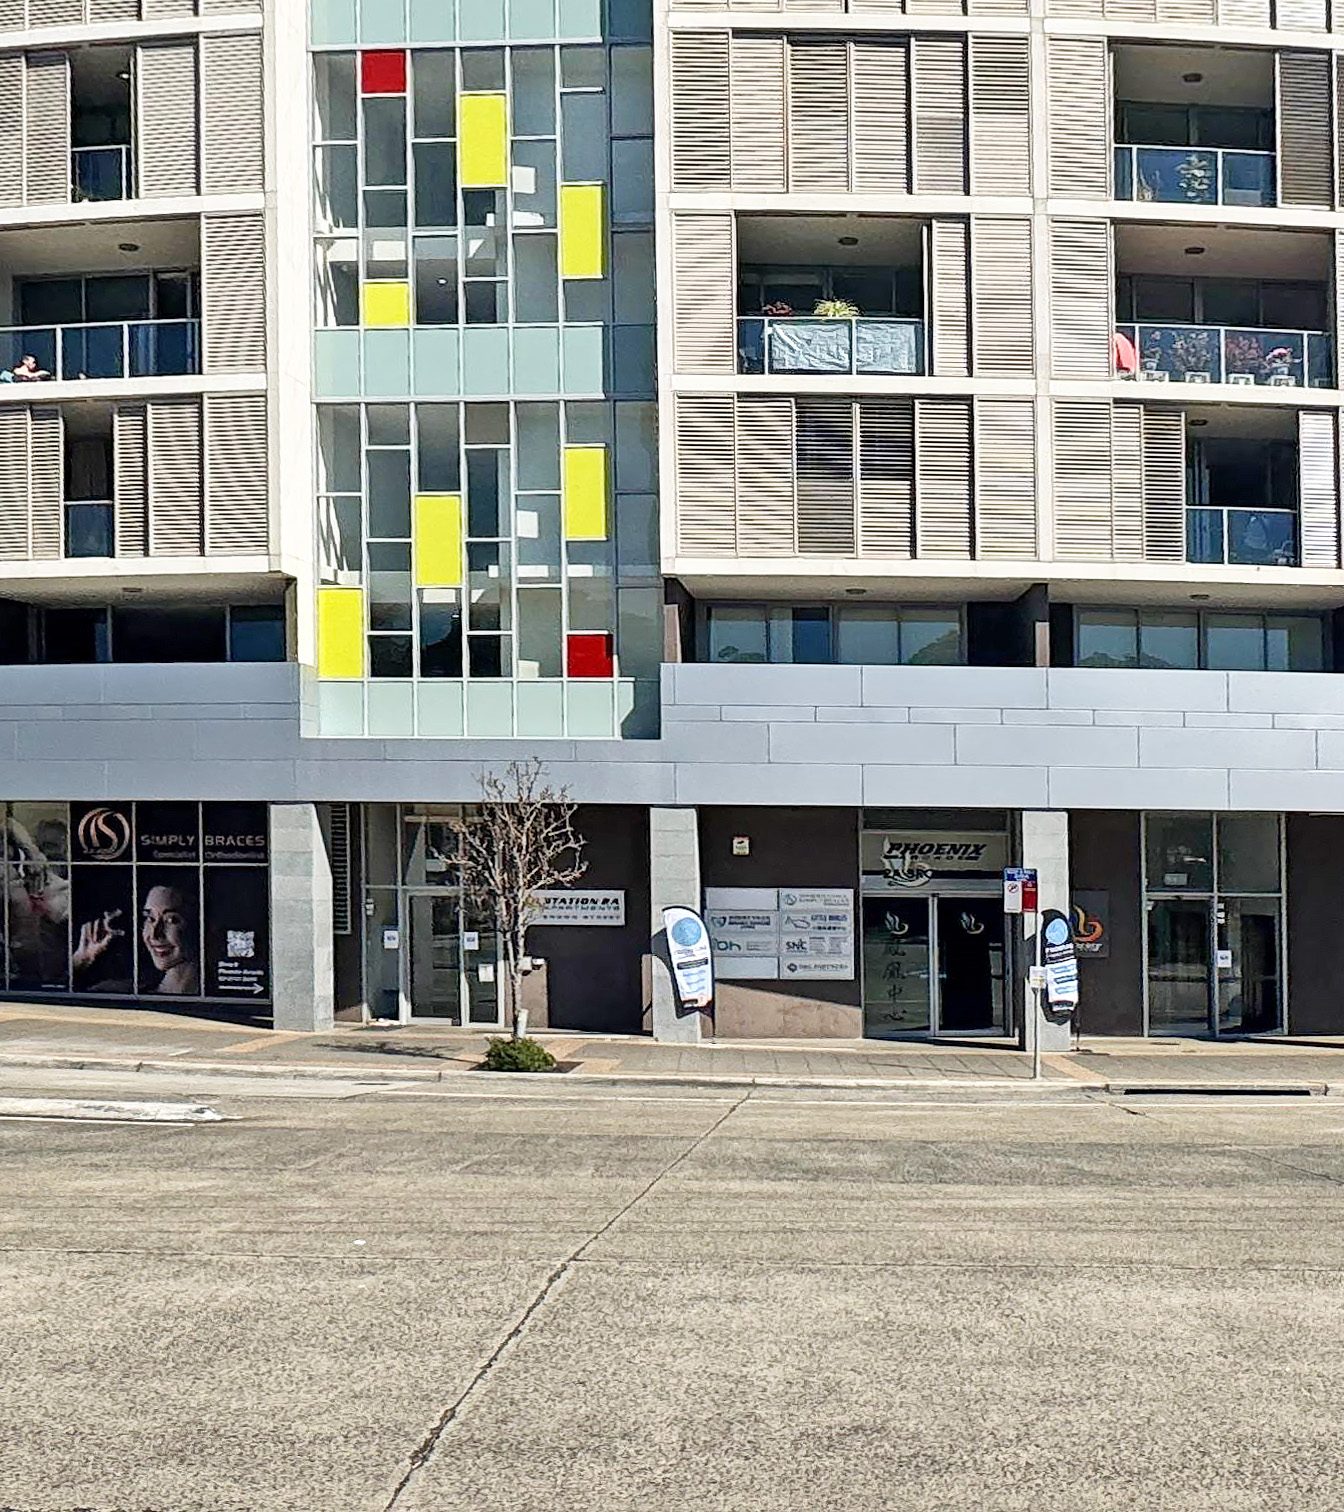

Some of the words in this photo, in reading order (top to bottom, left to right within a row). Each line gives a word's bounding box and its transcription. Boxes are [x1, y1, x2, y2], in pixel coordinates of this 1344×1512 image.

[140, 834, 196, 847] SIMPLY
[204, 835, 266, 847] BRACES
[886, 842, 987, 856] PHOENIX
